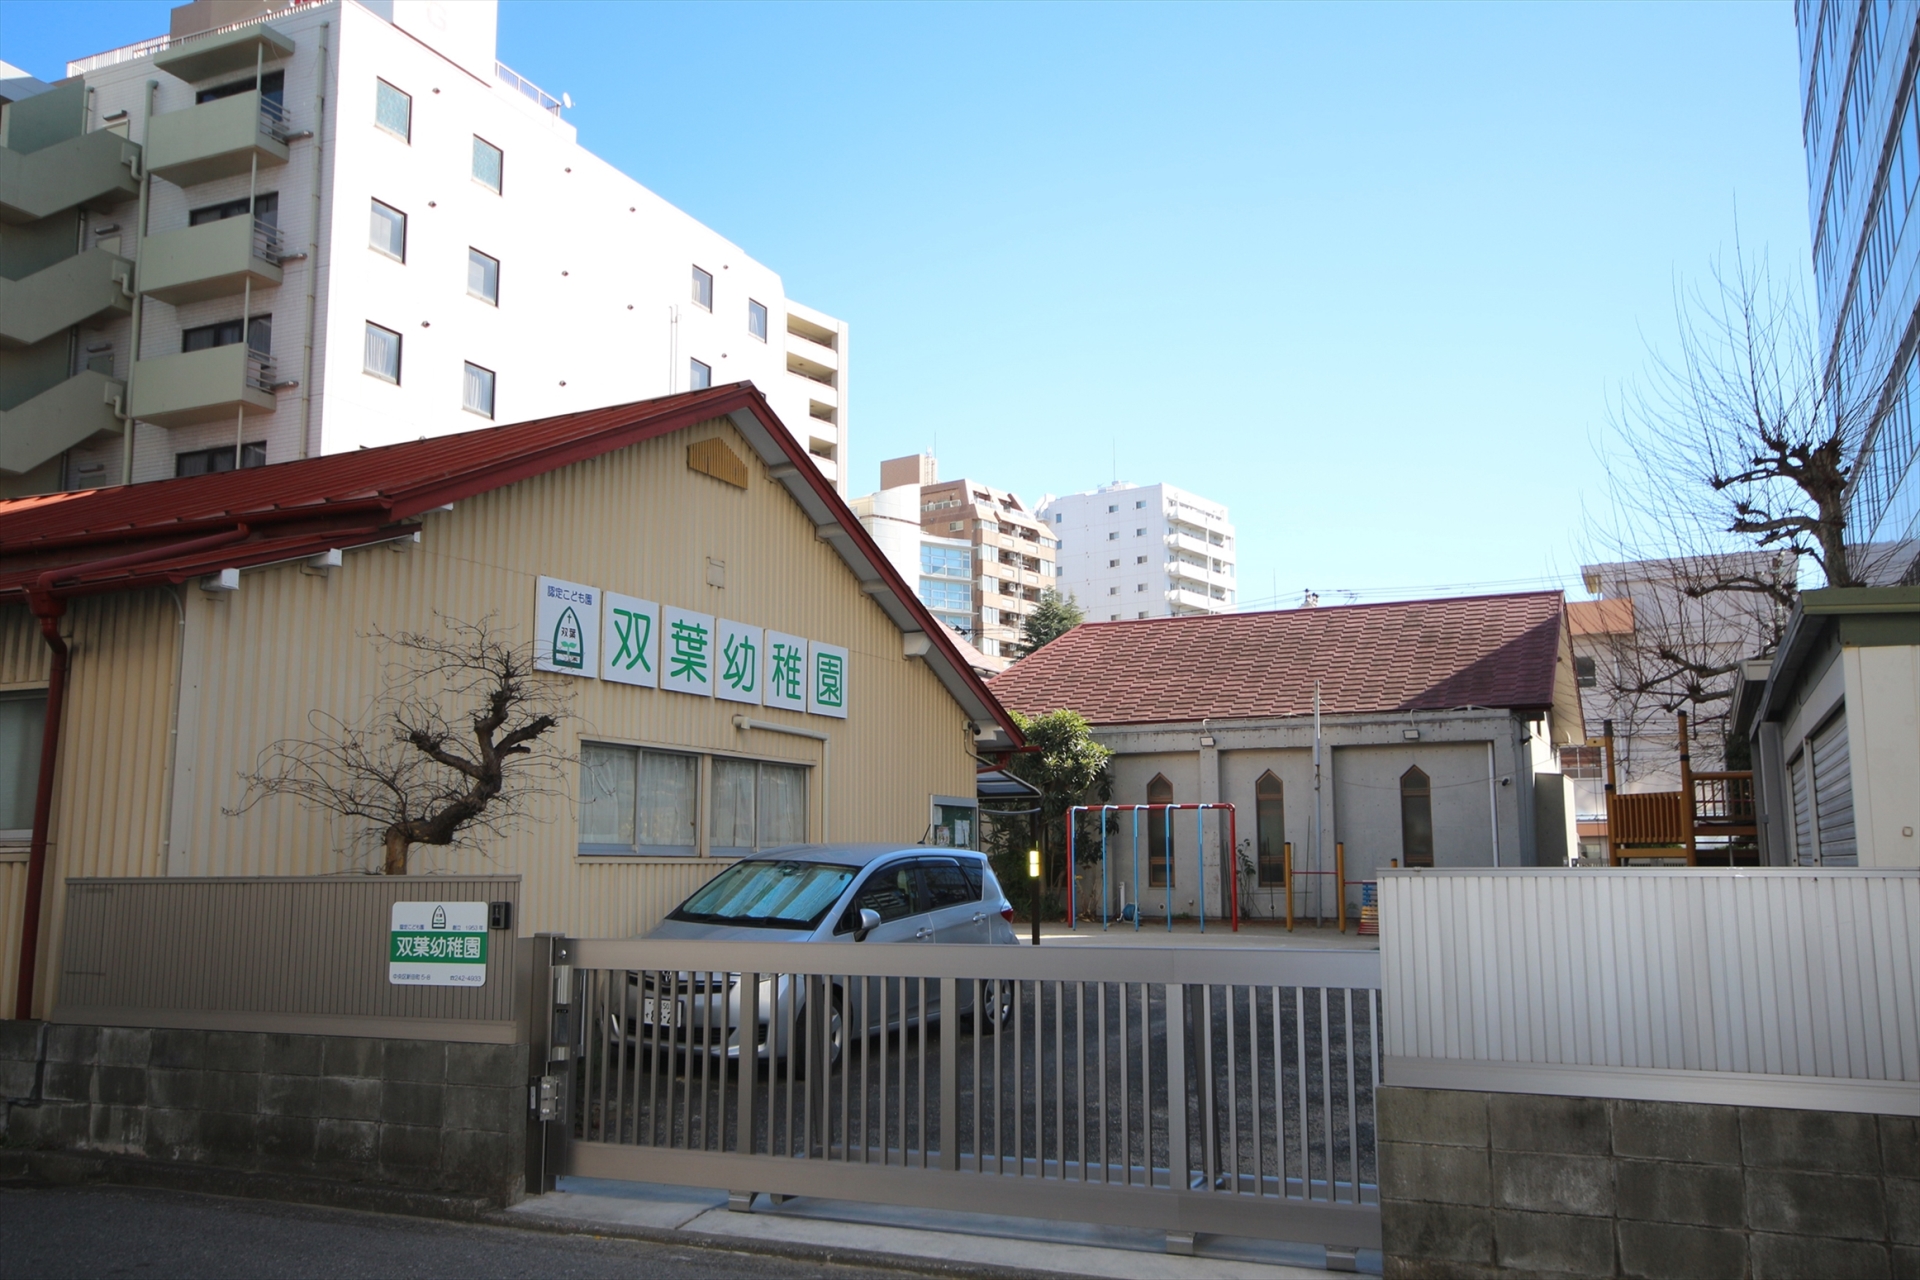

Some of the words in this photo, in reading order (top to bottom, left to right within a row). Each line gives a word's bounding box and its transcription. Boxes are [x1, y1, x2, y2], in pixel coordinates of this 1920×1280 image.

[547, 585, 592, 605] 認定こども園
[561, 626, 577, 639] 双葉
[611, 608, 842, 707] 双葉幼稚園
[396, 936, 481, 958] 双葉幼稚園
